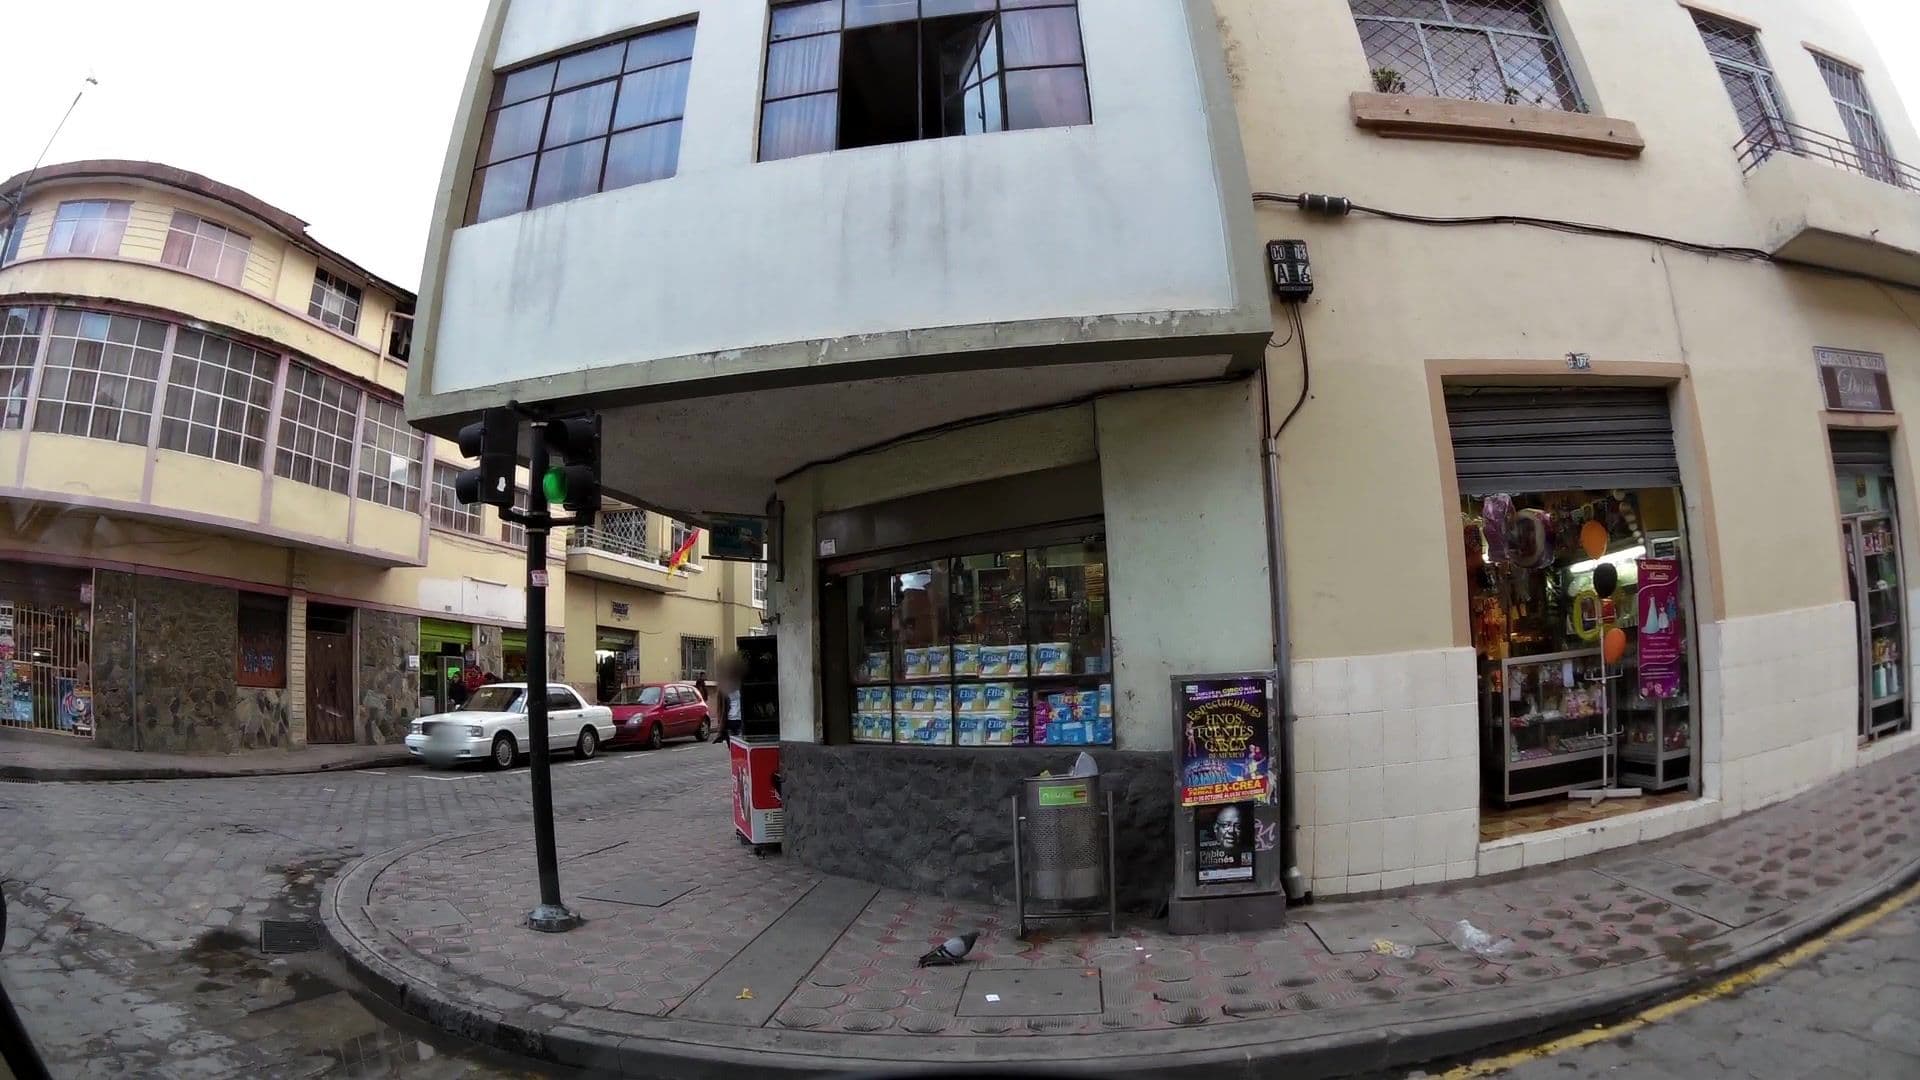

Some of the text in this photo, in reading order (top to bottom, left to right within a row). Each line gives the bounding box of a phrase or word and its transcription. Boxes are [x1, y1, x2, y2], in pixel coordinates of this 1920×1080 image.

[1040, 650, 1061, 659] Elite
[959, 689, 977, 698] Elite
[987, 688, 1006, 697] Elite
[1186, 698, 1262, 720] Espectaculares
[987, 720, 1007, 729] Elite
[1197, 725, 1255, 738] FUENTES
[1205, 738, 1247, 752] GASCA
[1214, 779, 1262, 793] EX-CREA
[1200, 850, 1225, 858] Pablo
[1200, 855, 1234, 865] Milanés
